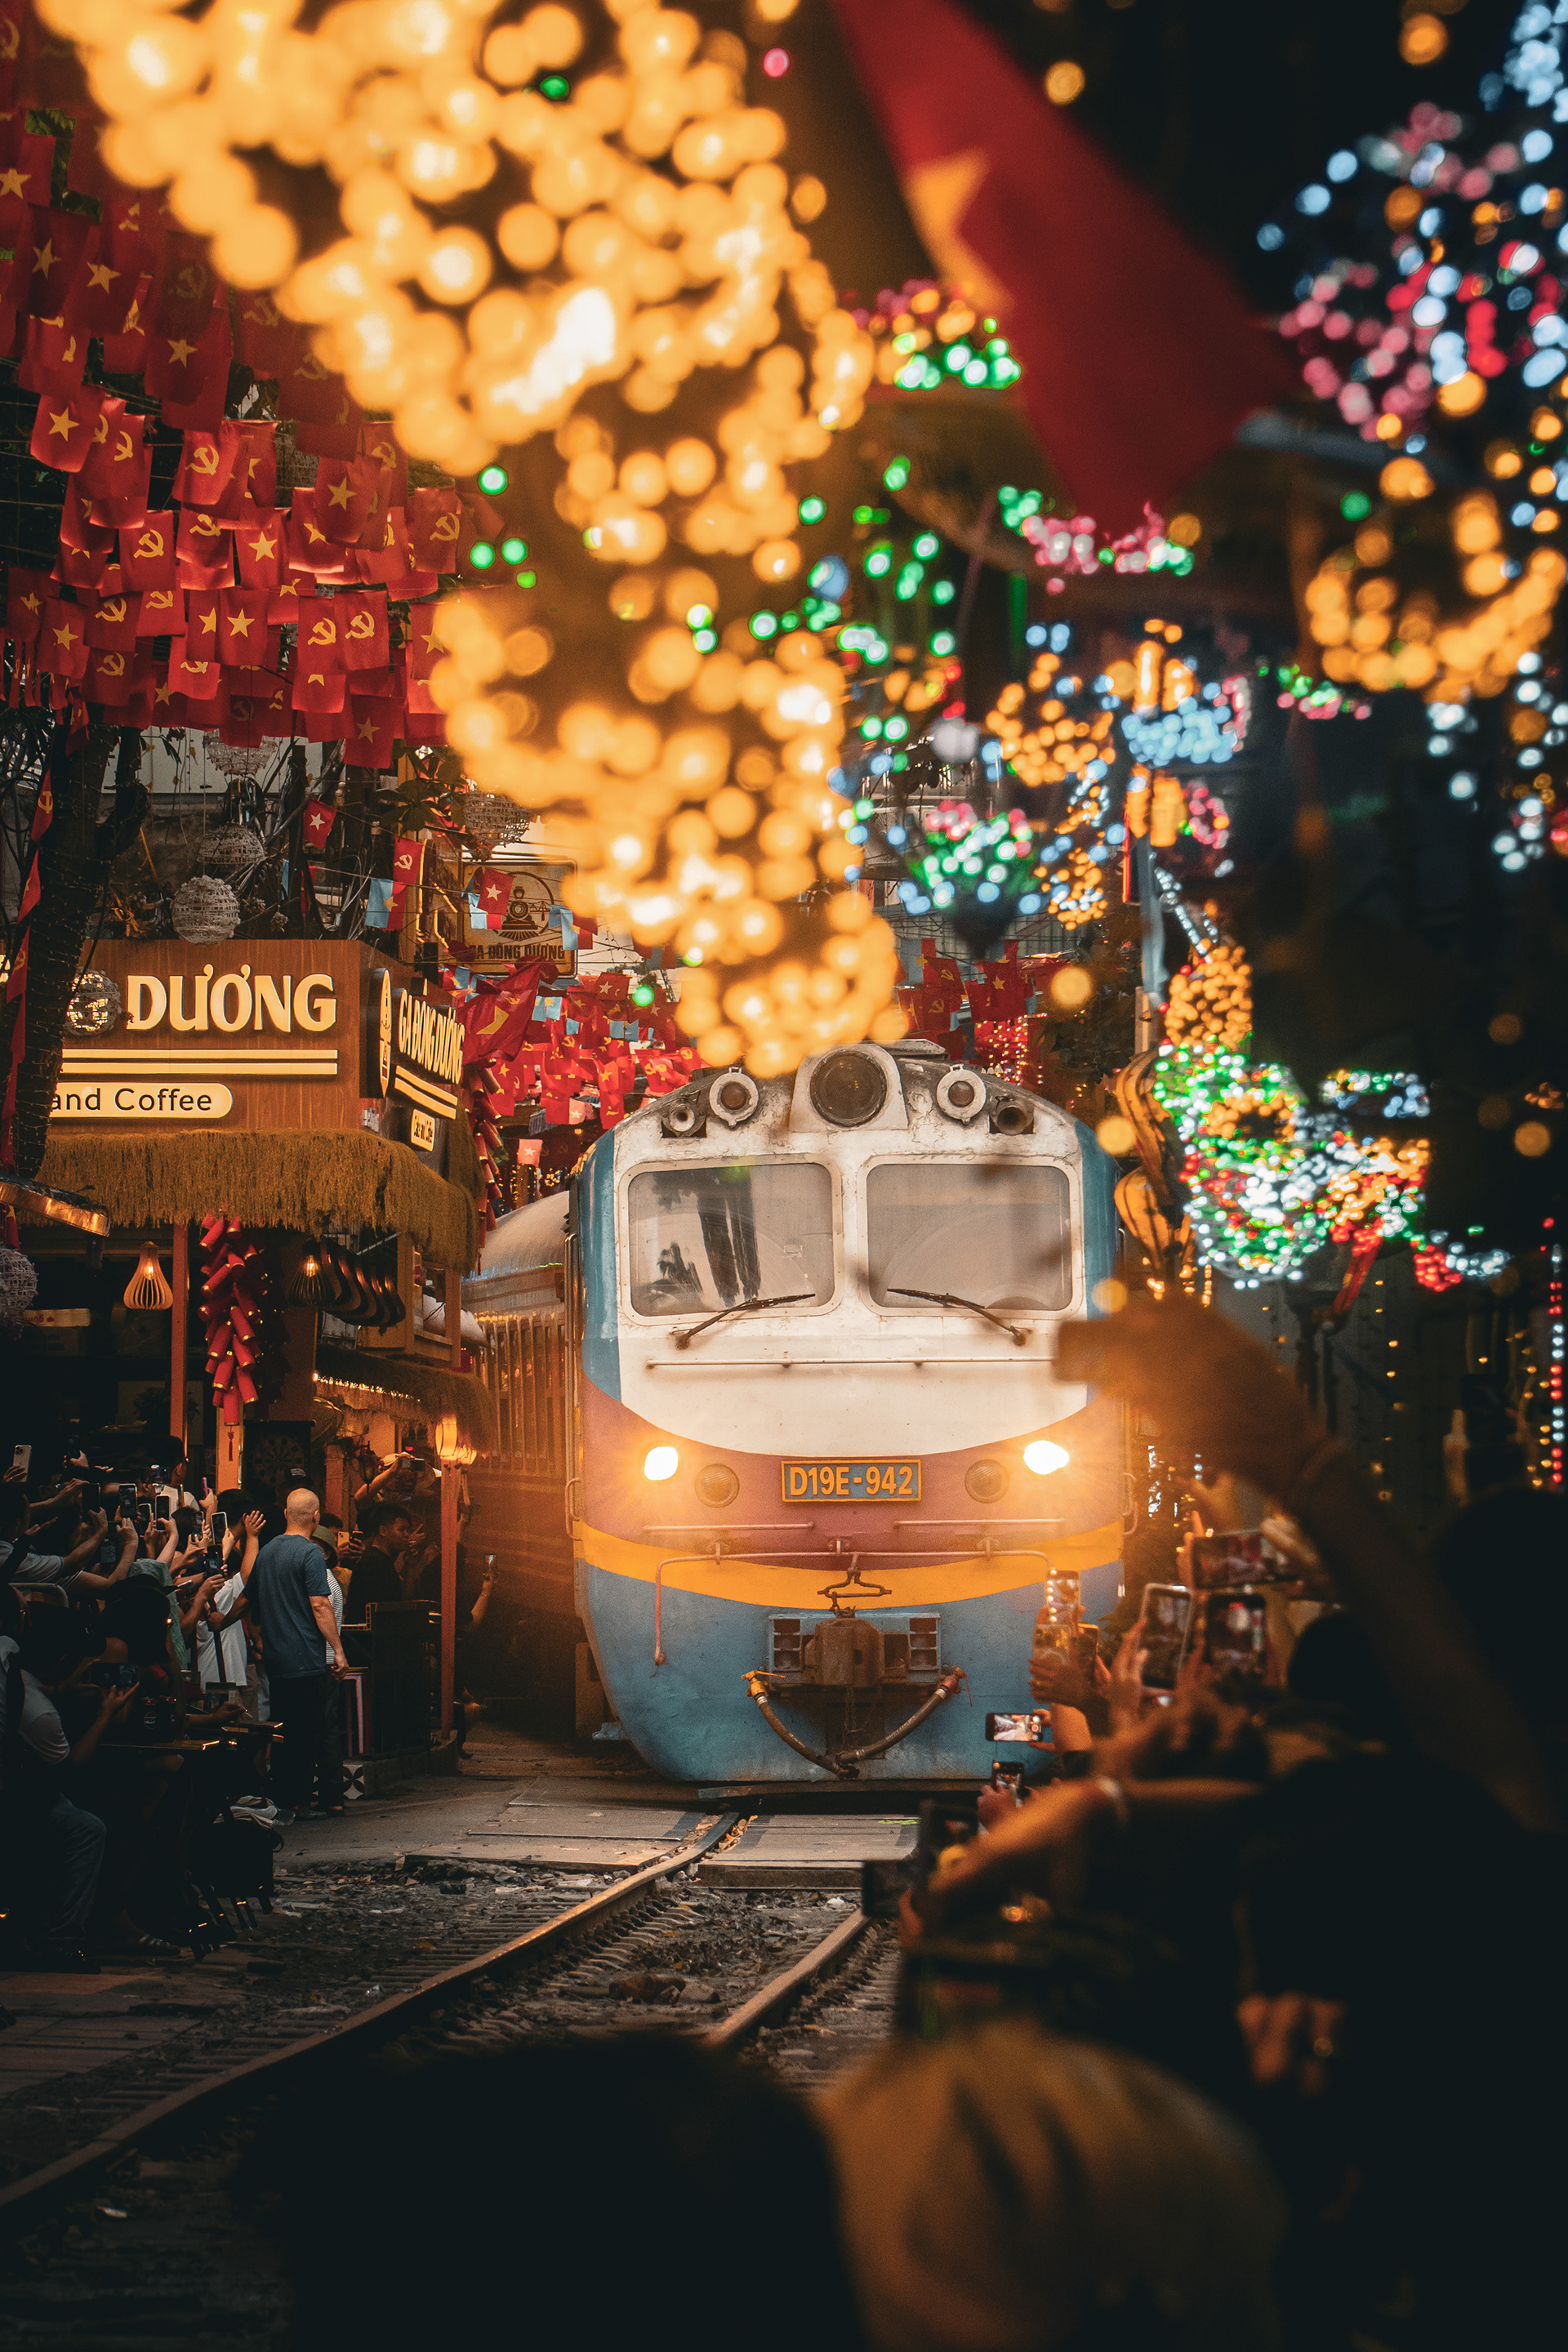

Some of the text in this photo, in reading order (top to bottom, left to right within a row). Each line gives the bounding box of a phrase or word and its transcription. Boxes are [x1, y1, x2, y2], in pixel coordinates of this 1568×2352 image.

[127, 964, 336, 1032] DƯƠNG
[398, 989, 412, 1055] GA
[51, 1088, 212, 1111] and Coffee
[790, 1466, 913, 1496] D19E-942
